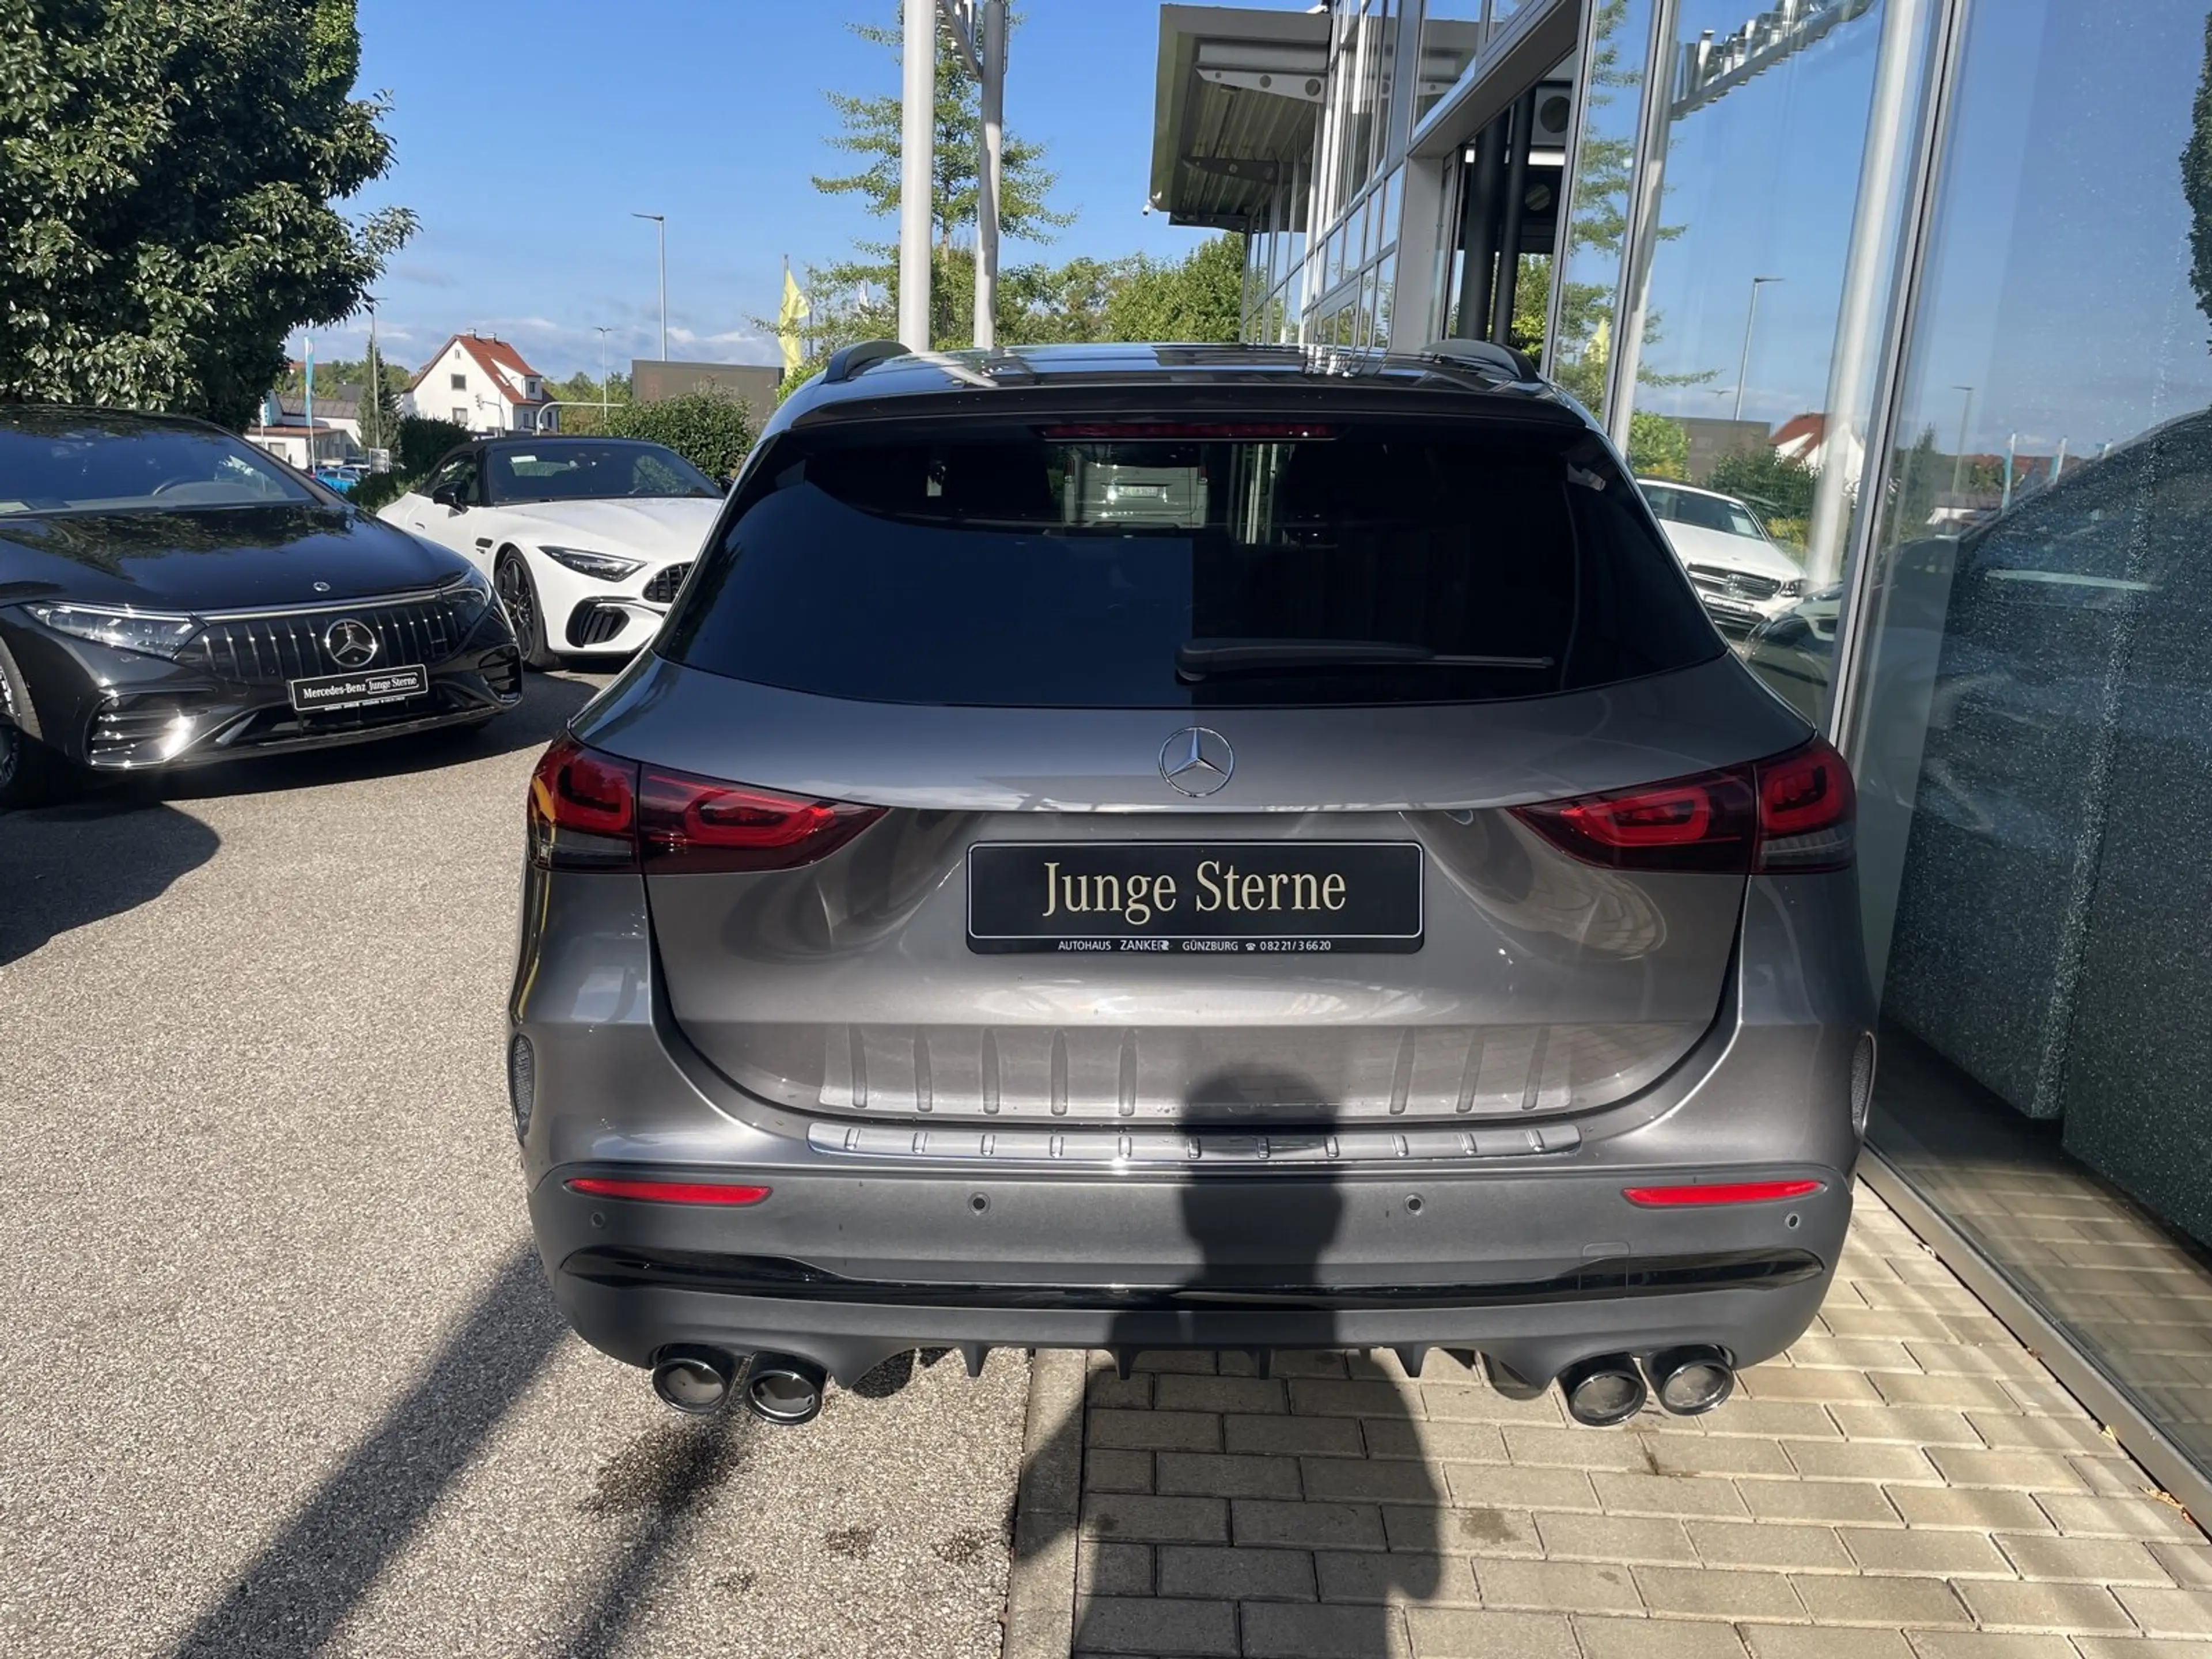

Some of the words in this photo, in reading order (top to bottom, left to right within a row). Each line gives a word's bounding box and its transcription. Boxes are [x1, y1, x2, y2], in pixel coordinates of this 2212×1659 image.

[303, 683, 366, 699] Mercedes-Benz
[369, 680, 391, 691] Junge
[392, 677, 417, 687] Sterne
[1042, 862, 1177, 926] Junge
[1196, 861, 1346, 912] Sterne
[1058, 940, 1111, 950] AUTOHAUS
[1182, 939, 1238, 951] GÜNZBURG
